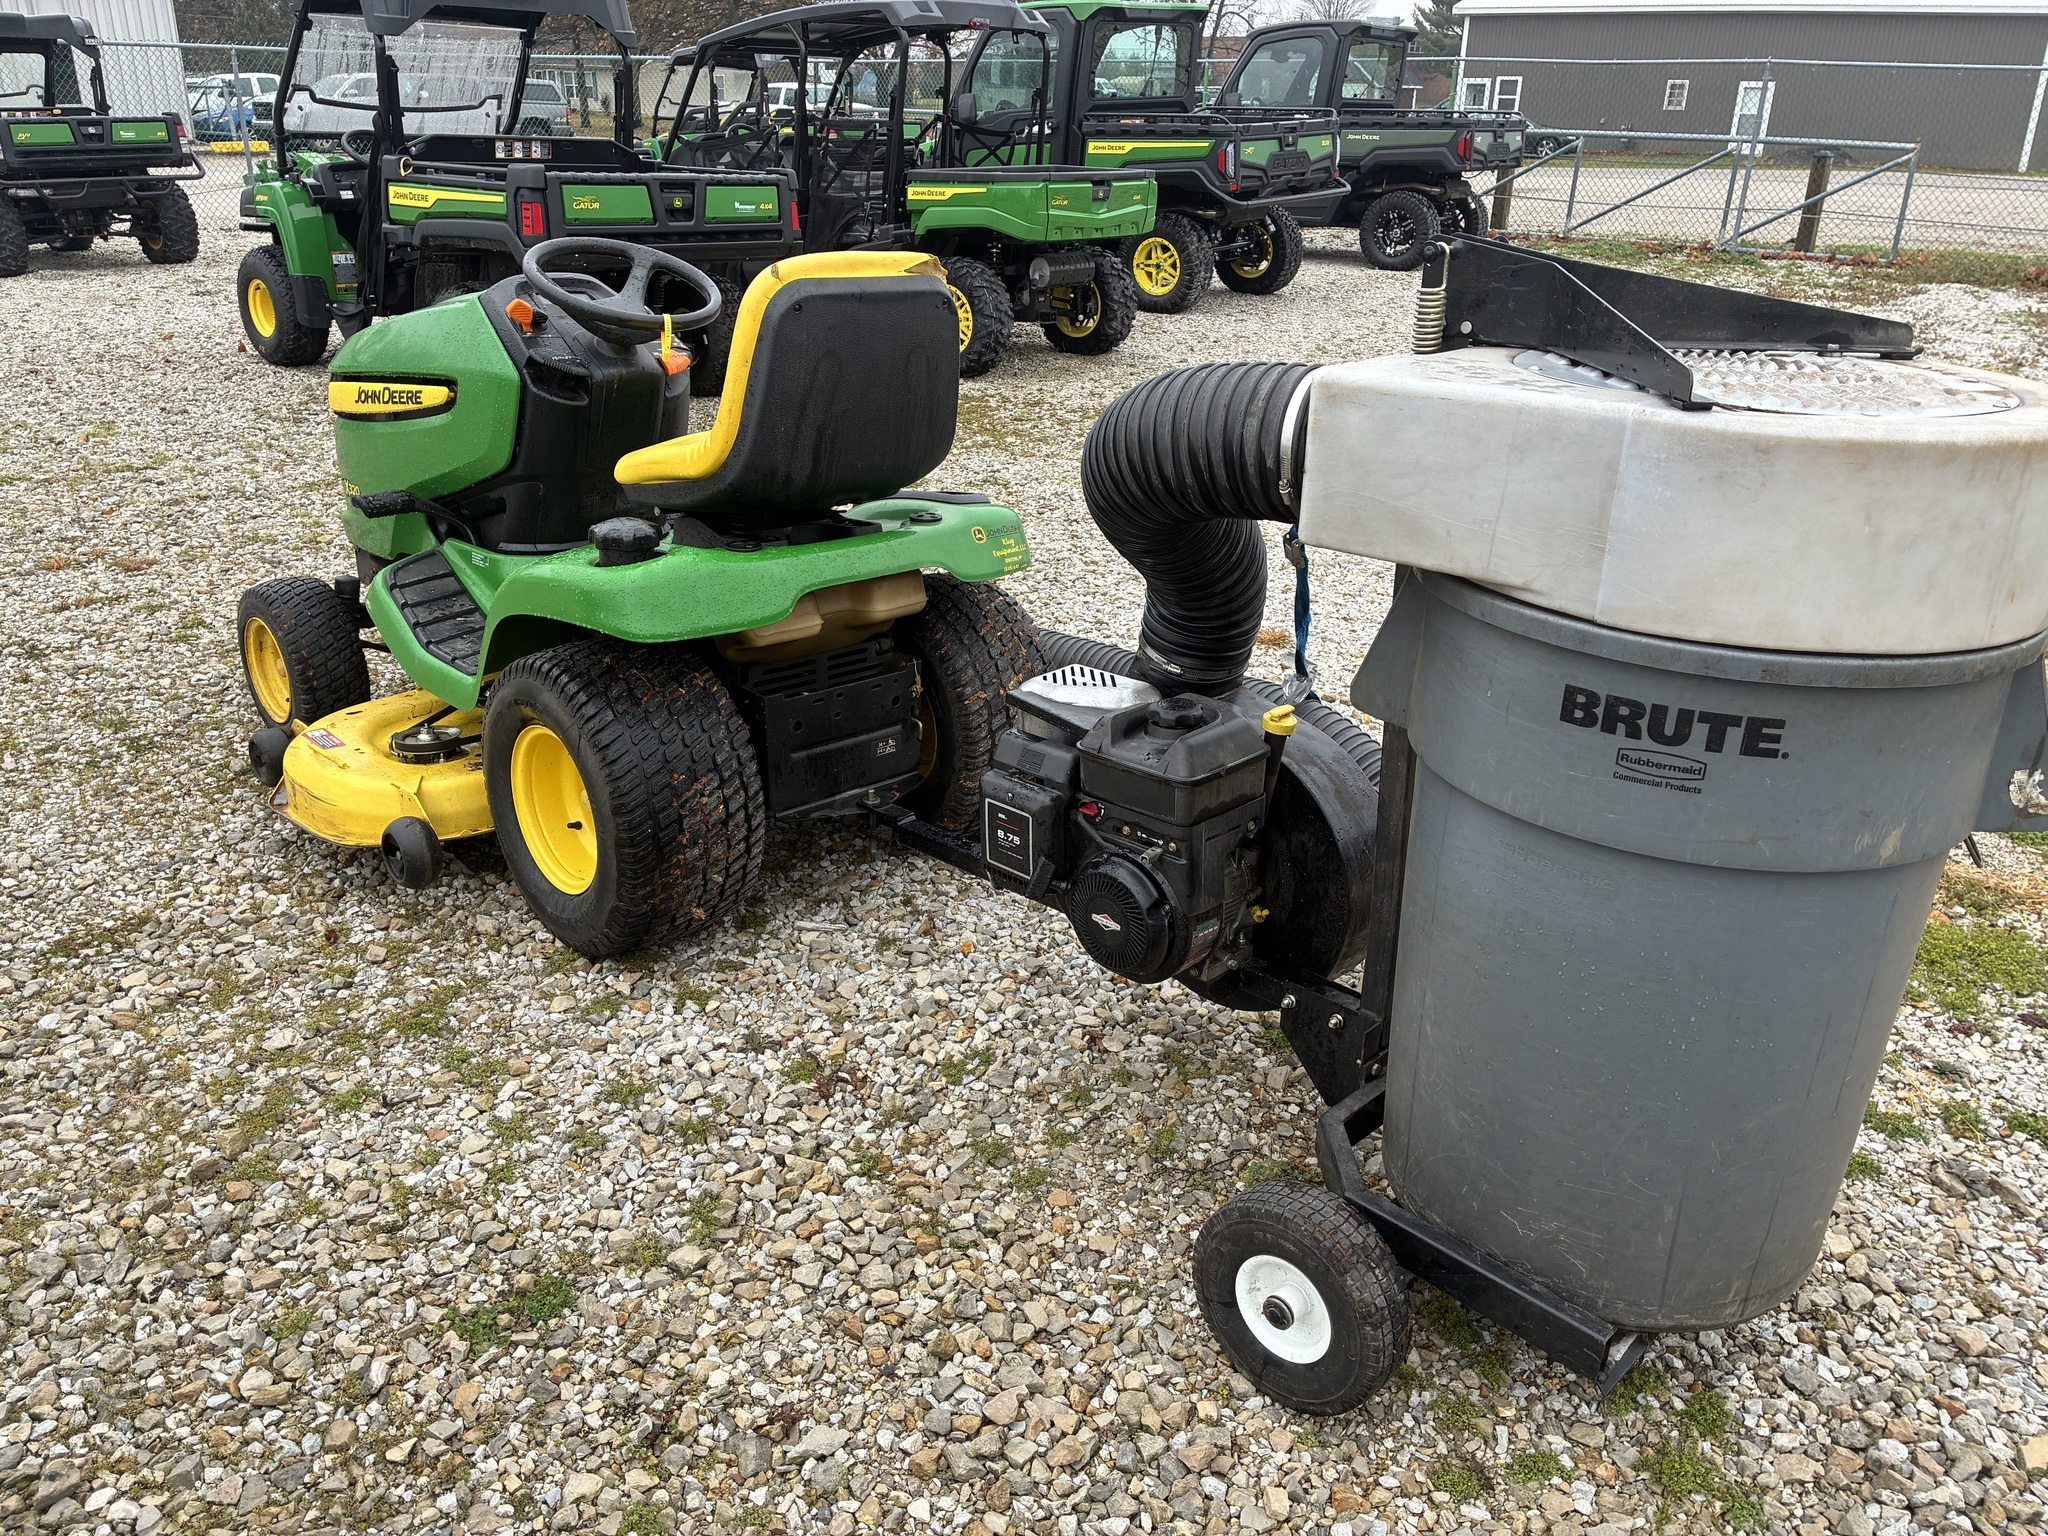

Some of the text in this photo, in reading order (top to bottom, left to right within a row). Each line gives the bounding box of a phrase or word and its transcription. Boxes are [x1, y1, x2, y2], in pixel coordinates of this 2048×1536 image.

[1272, 155, 1306, 169] GATOR
[392, 190, 429, 202] JOHN DEERE
[573, 201, 600, 210] GATOR
[759, 202, 774, 210] 4x4
[355, 386, 423, 405] JOHN DEERE
[986, 528, 1002, 537] JOHN
[1559, 683, 1787, 759] BRUTE
[1620, 752, 1703, 777] Rubbermaid
[1612, 771, 1702, 795] Commercial Products
[997, 829, 1021, 845] 8.75
